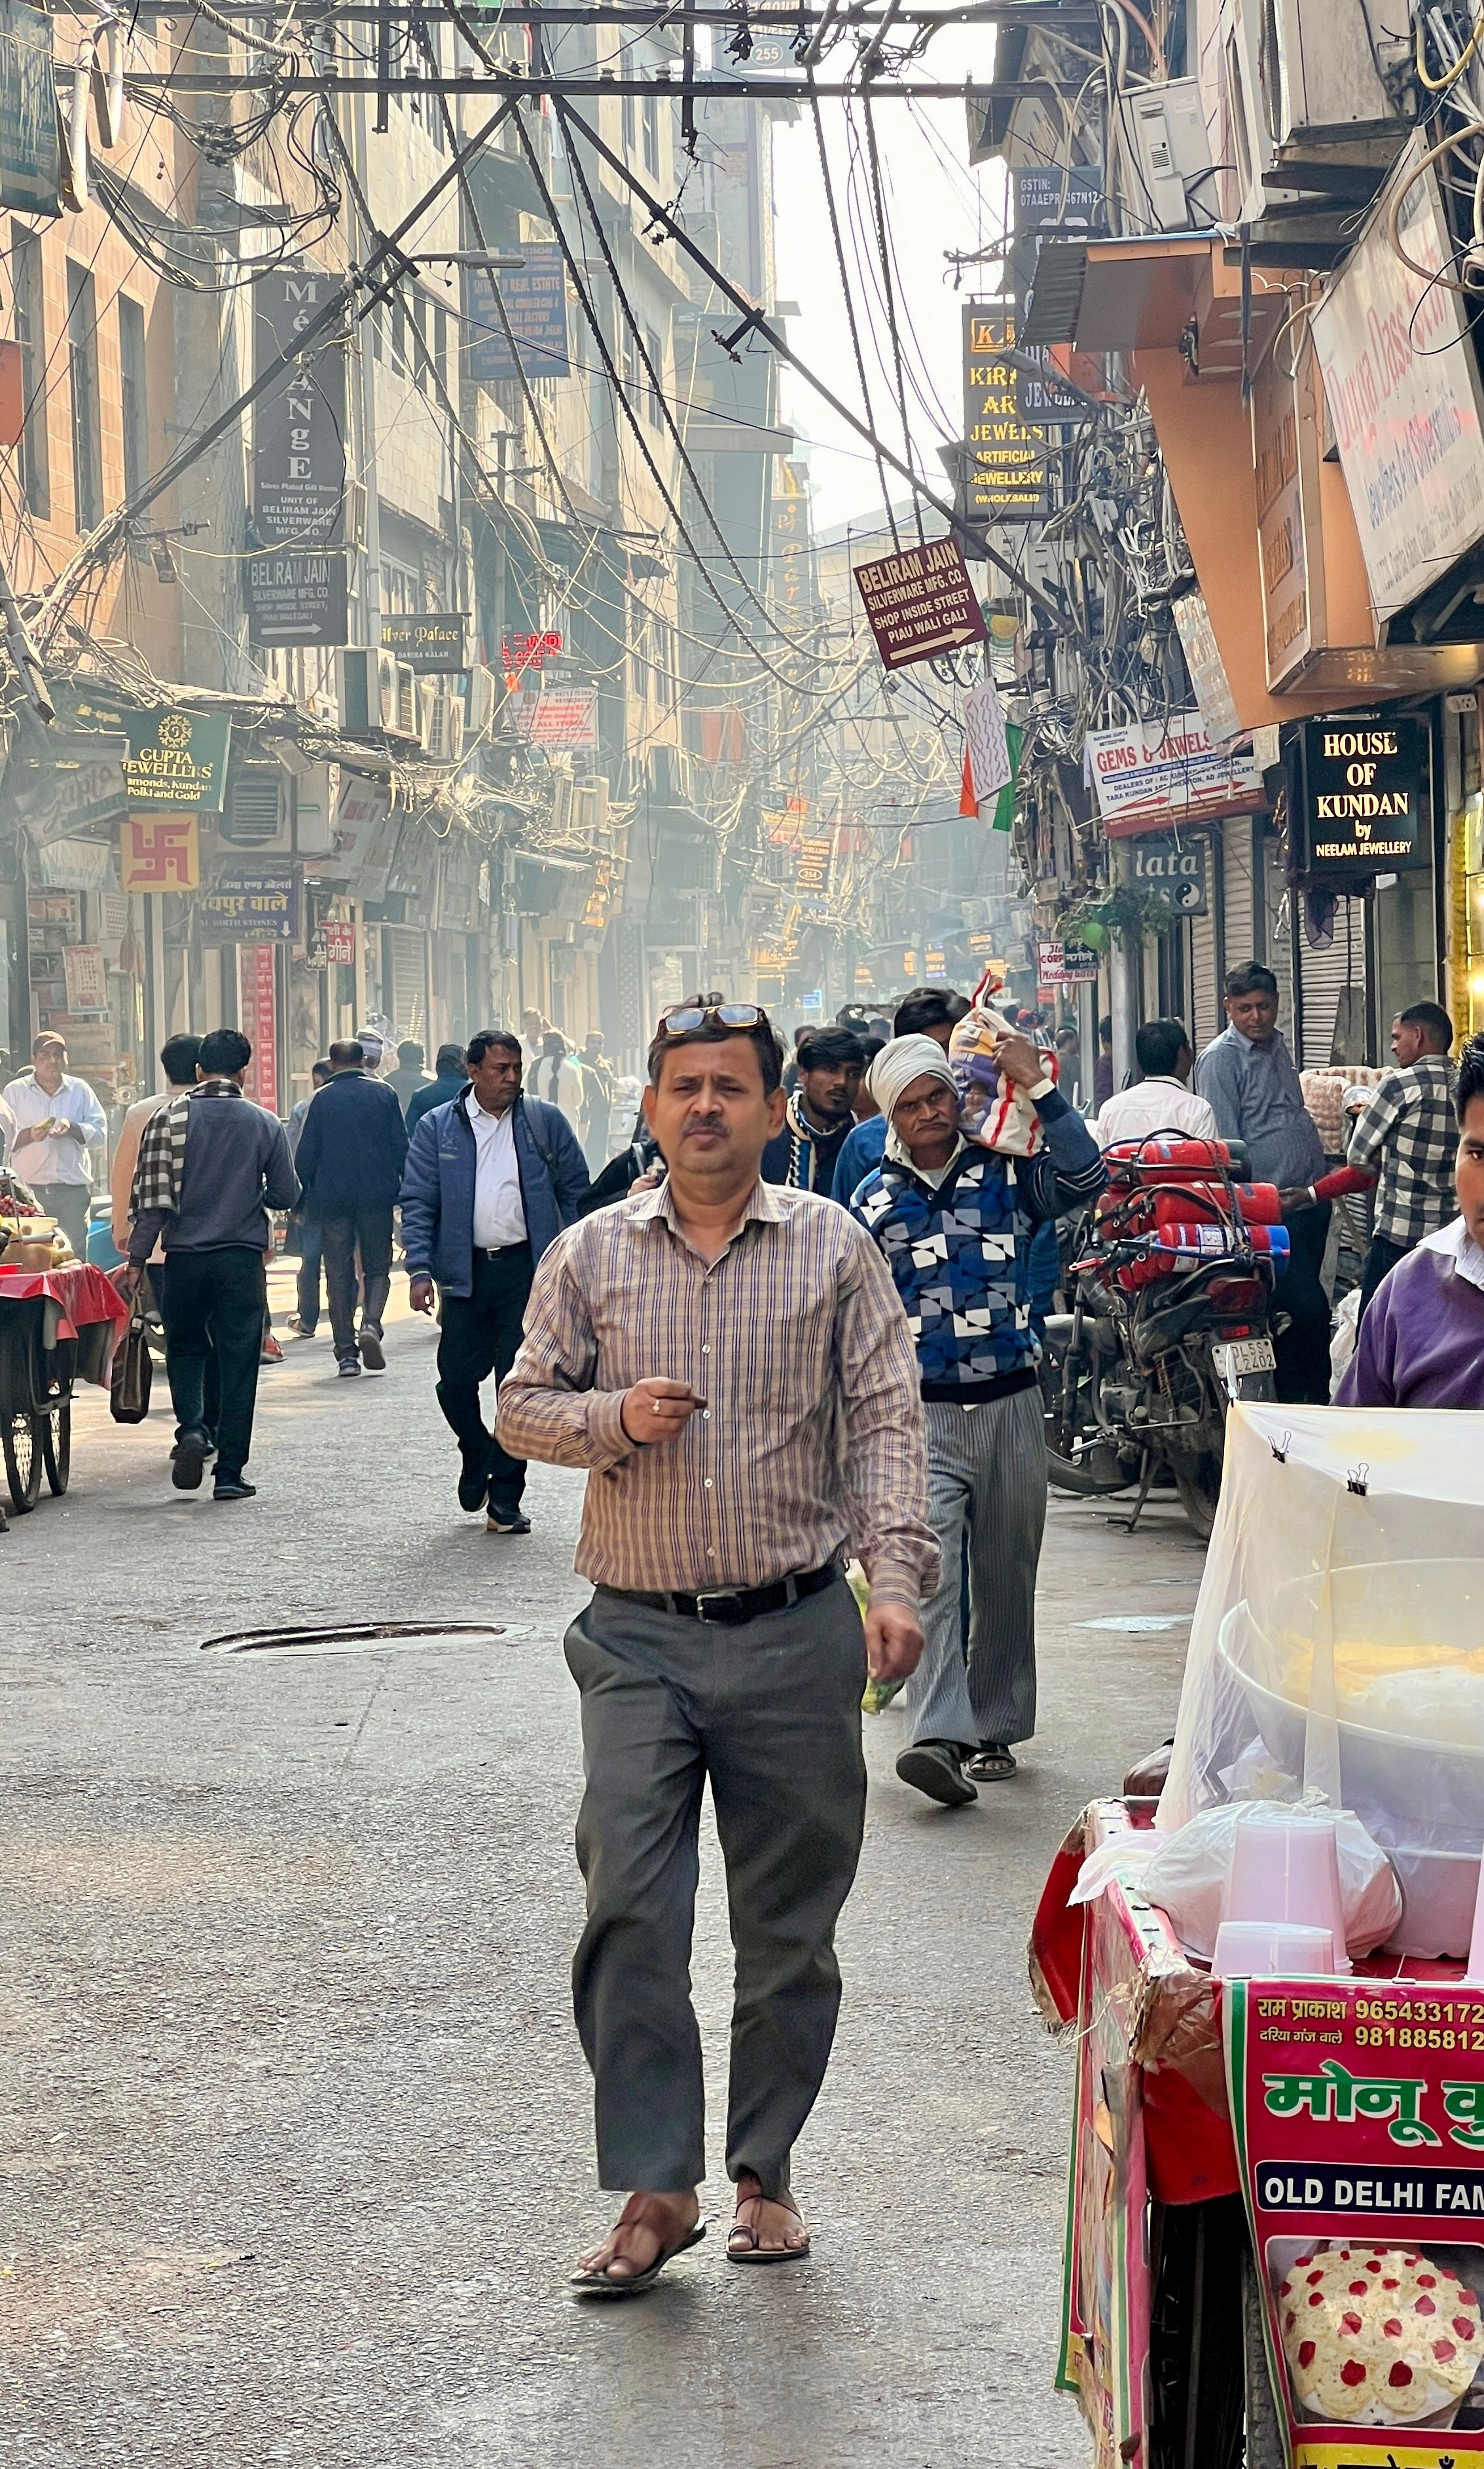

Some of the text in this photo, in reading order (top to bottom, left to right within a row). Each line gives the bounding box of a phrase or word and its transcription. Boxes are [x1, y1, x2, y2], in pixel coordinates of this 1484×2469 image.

[755, 47, 779, 60] 255
[1021, 178, 1051, 191] GSTIN:
[982, 395, 1017, 414] AR
[970, 421, 1043, 441] JEWELS
[976, 450, 1036, 464] ARTIFICIAL
[262, 505, 336, 516] BELIRAM JAIN
[266, 516, 333, 526] SILVERWARE
[251, 559, 331, 587] BELIRAM JAIN
[858, 541, 960, 594] BELIRAM JAIN
[253, 588, 296, 601] SILVERWARE
[868, 568, 966, 612] SILVERWARE MFG. CO.
[874, 589, 969, 630] SHOP INSIDE STREET
[888, 608, 968, 644] PIAU WALI GALI
[380, 625, 458, 648] ilver Palace
[1096, 746, 1138, 773] GEMS
[1159, 730, 1213, 760] JEWELS
[1324, 731, 1398, 757] HOUSE
[140, 748, 193, 765] GUPTA
[1346, 763, 1377, 786] OF
[153, 788, 174, 799] and
[175, 790, 200, 800] Gold
[1106, 793, 1123, 802] TARA
[1125, 787, 1153, 797] KUNDAN
[1114, 779, 1144, 792] DEALERS
[1316, 793, 1408, 818] KUNDAN
[1354, 819, 1371, 841] by
[1316, 841, 1412, 858] NEELAM JEWELLERY
[1242, 1354, 1274, 1370] 2402
[1258, 1998, 1286, 2018] राम
[1292, 1999, 1347, 2021] प्राकाश
[1259, 2026, 1290, 2043] दरिया
[1293, 2028, 1316, 2043] गंज
[1320, 2029, 1343, 2044] वाले
[1262, 2058, 1443, 2147] मोनू
[1265, 2177, 1324, 2204] OLD
[1335, 2180, 1423, 2208] DELHI
